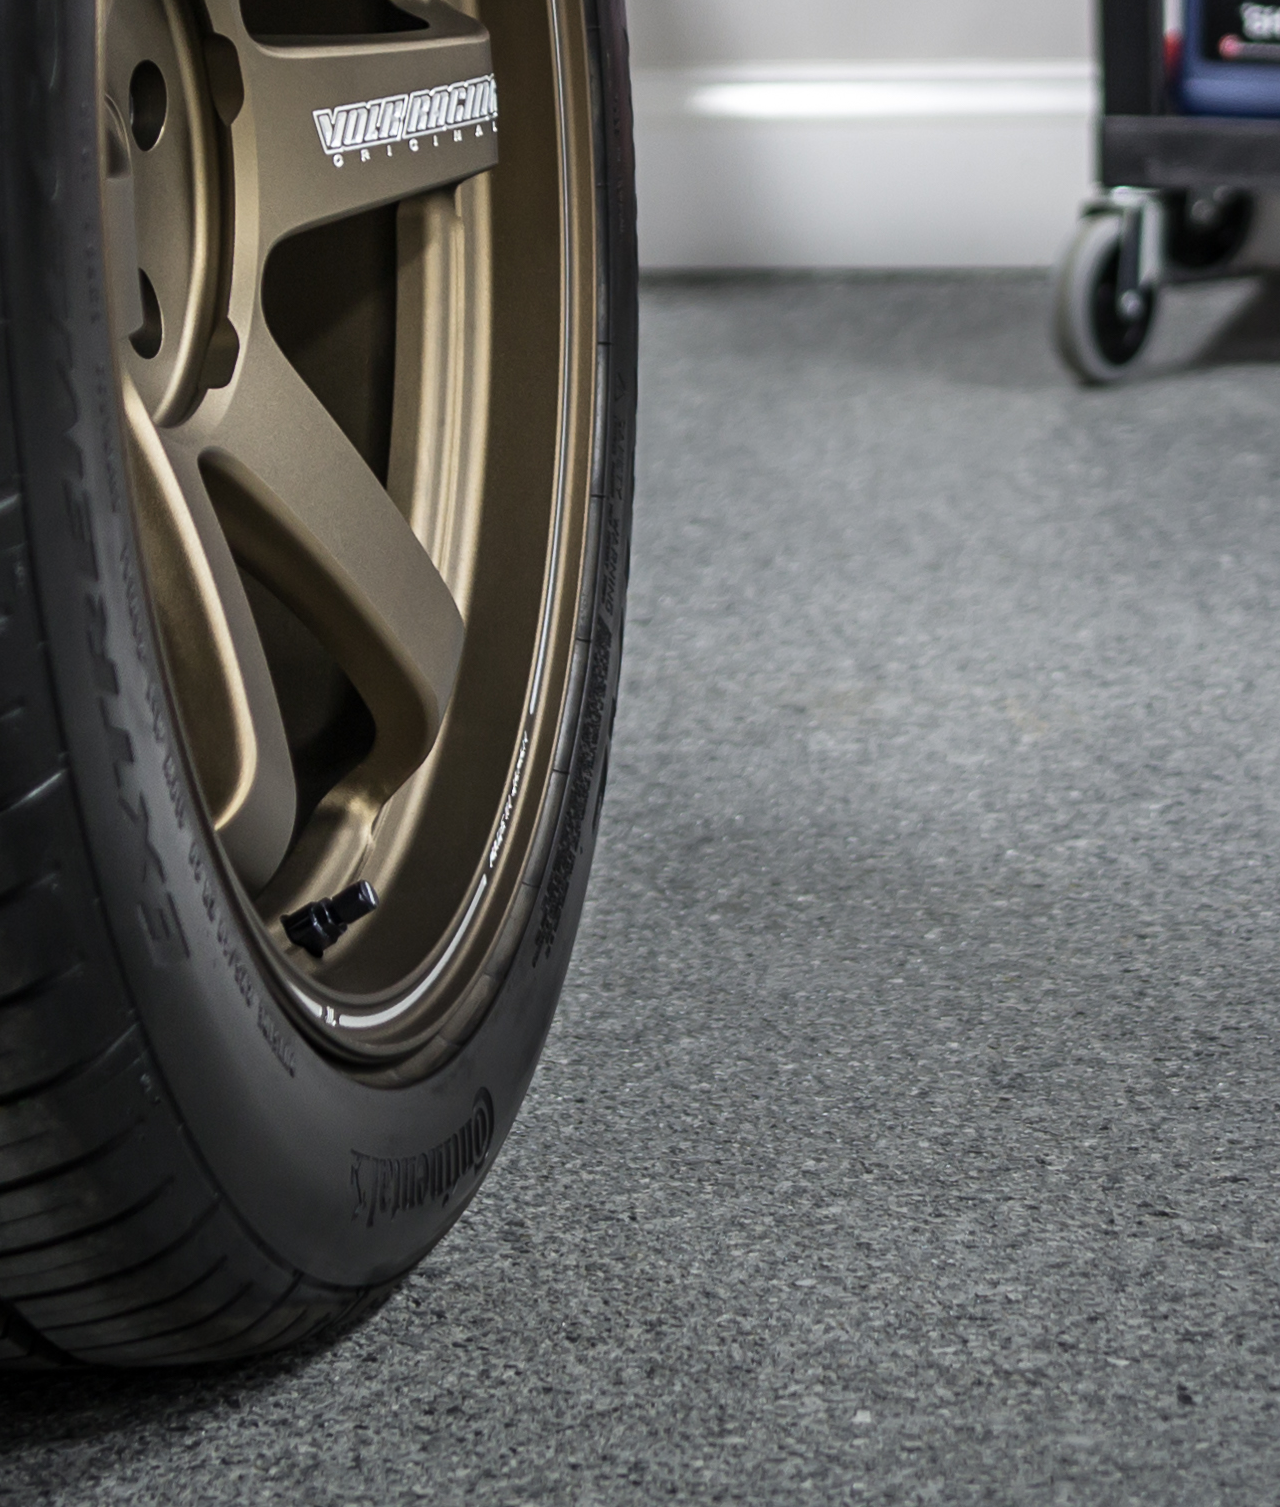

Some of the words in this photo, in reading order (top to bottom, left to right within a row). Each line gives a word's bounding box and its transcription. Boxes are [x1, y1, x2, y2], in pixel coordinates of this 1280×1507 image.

[313, 95, 409, 155] VOLK
[402, 73, 498, 139] RACIN
[370, 1086, 496, 1228] Continental
